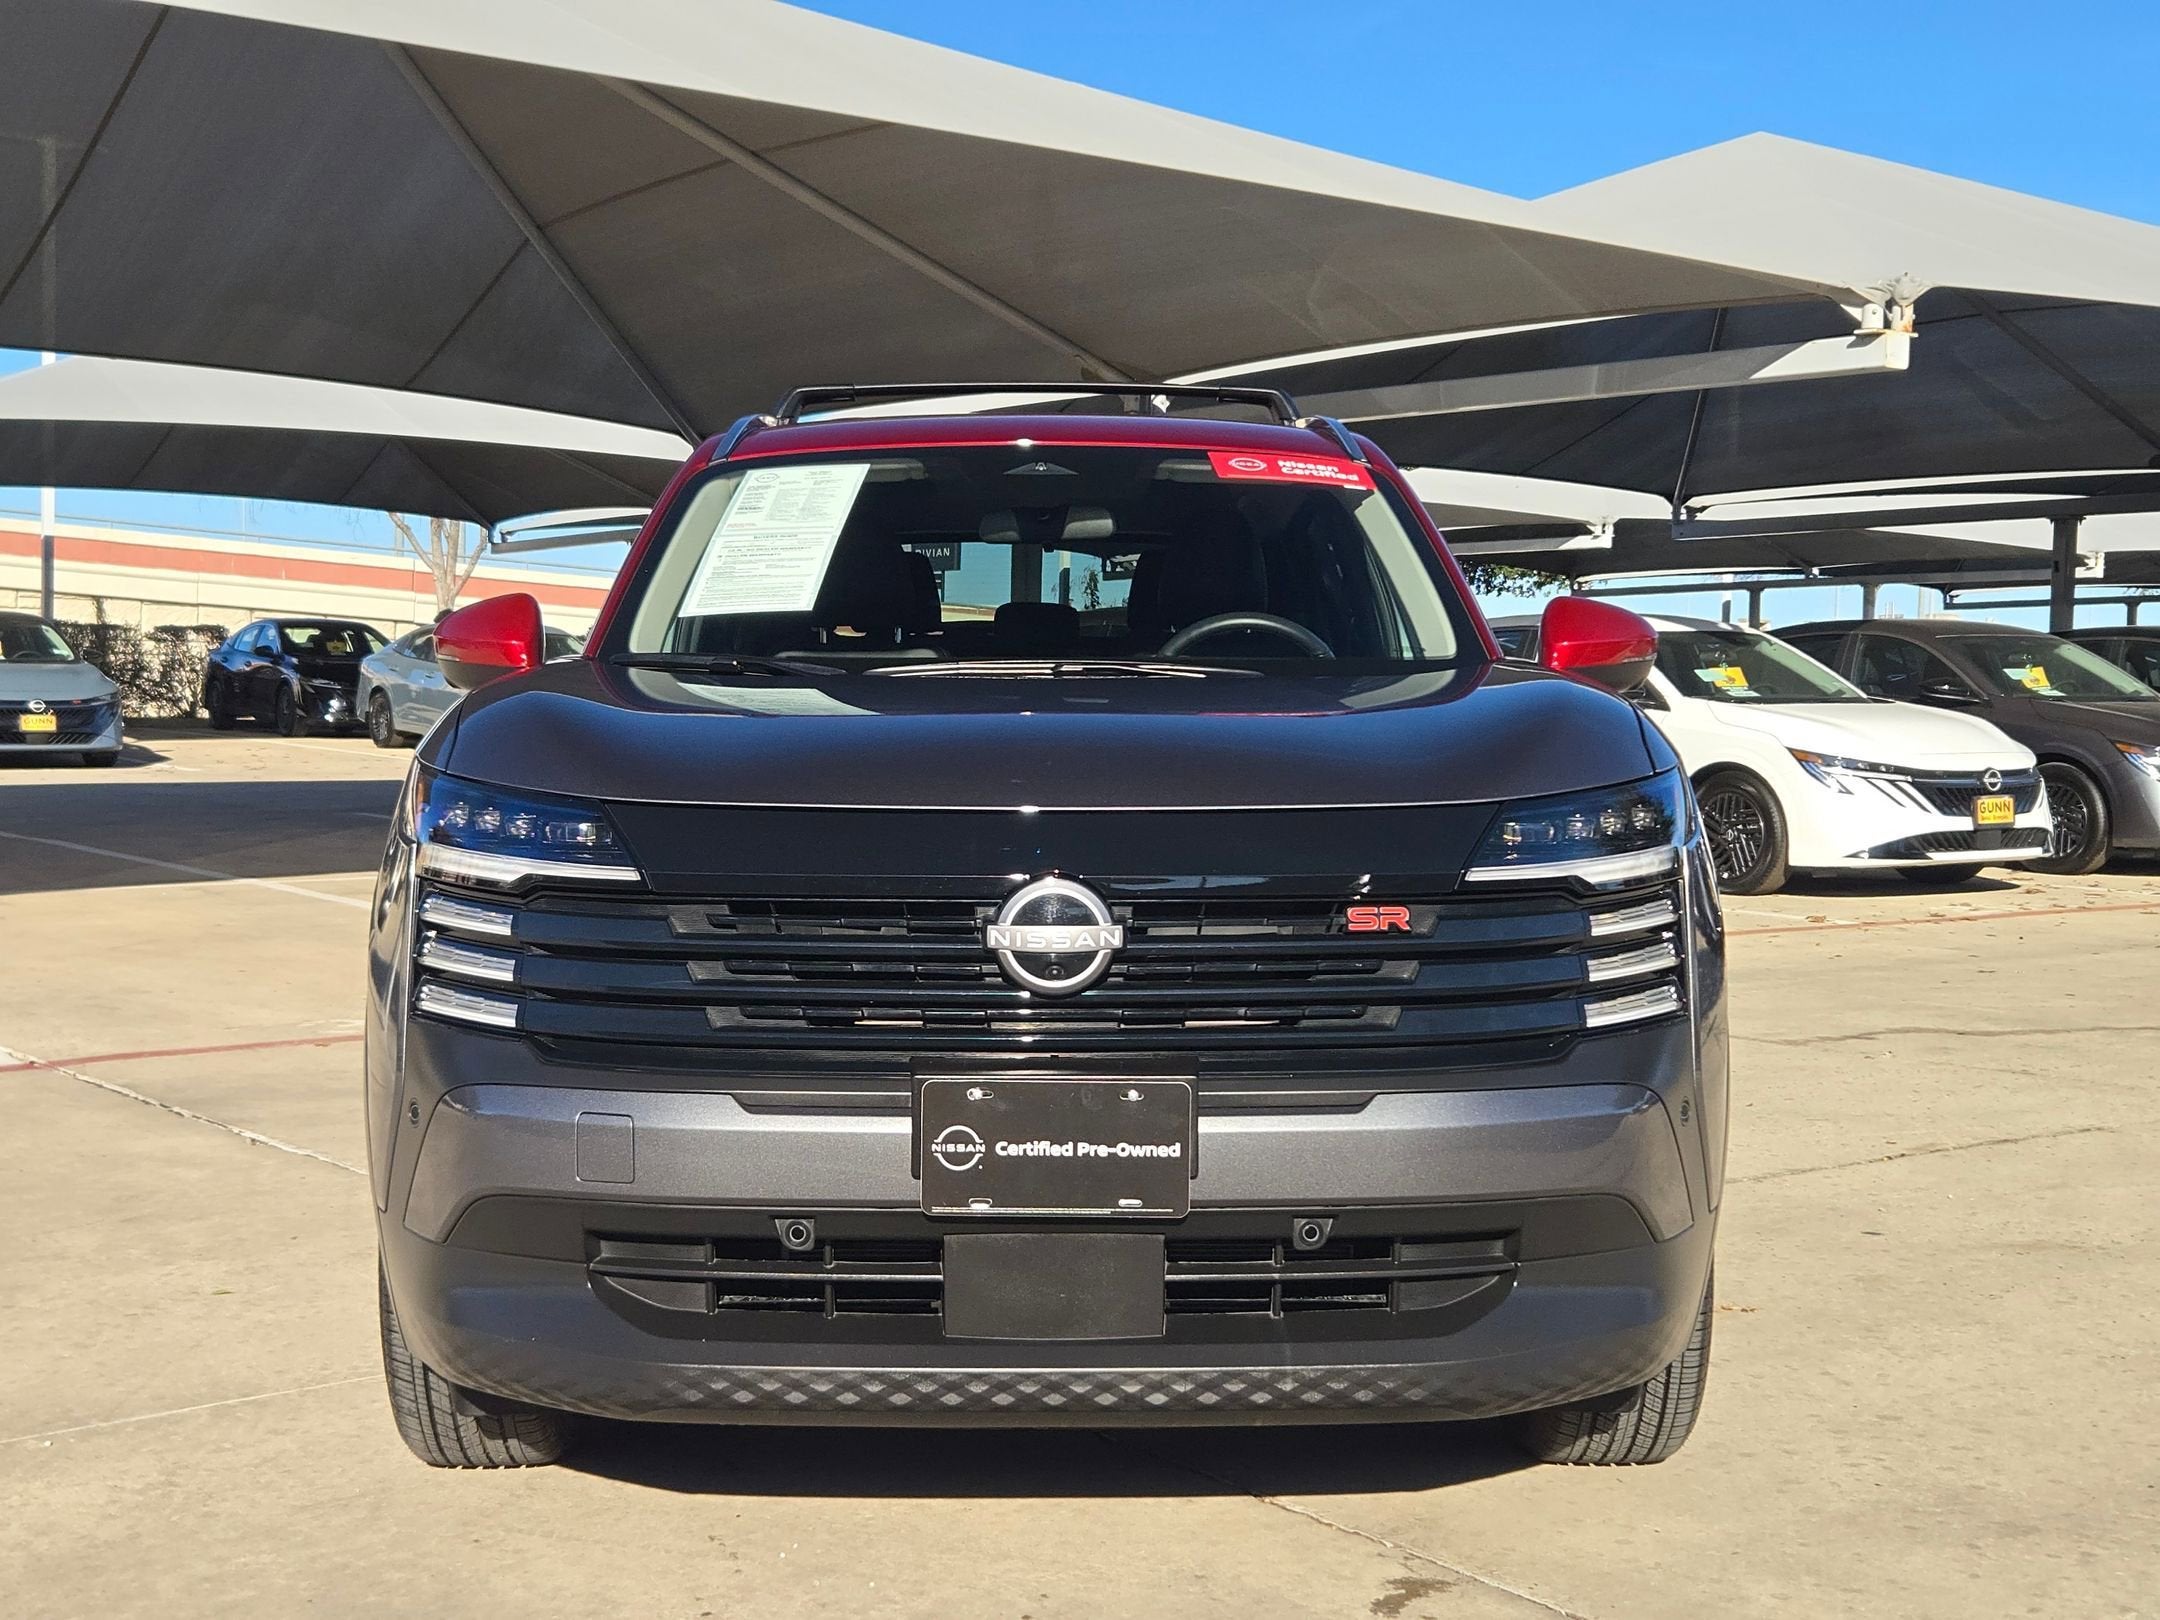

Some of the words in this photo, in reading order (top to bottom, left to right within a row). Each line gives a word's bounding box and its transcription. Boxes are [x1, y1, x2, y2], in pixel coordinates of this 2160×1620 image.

[1277, 460, 1339, 473] Nissan
[1281, 466, 1359, 481] Certified
[1979, 800, 2011, 814] GUNN
[1347, 906, 1411, 932] SR
[989, 928, 1121, 949] NISSAN
[931, 1143, 986, 1153] NISSAN
[995, 1141, 1074, 1158] Certified
[1077, 1142, 1181, 1158] Pre-Owned
